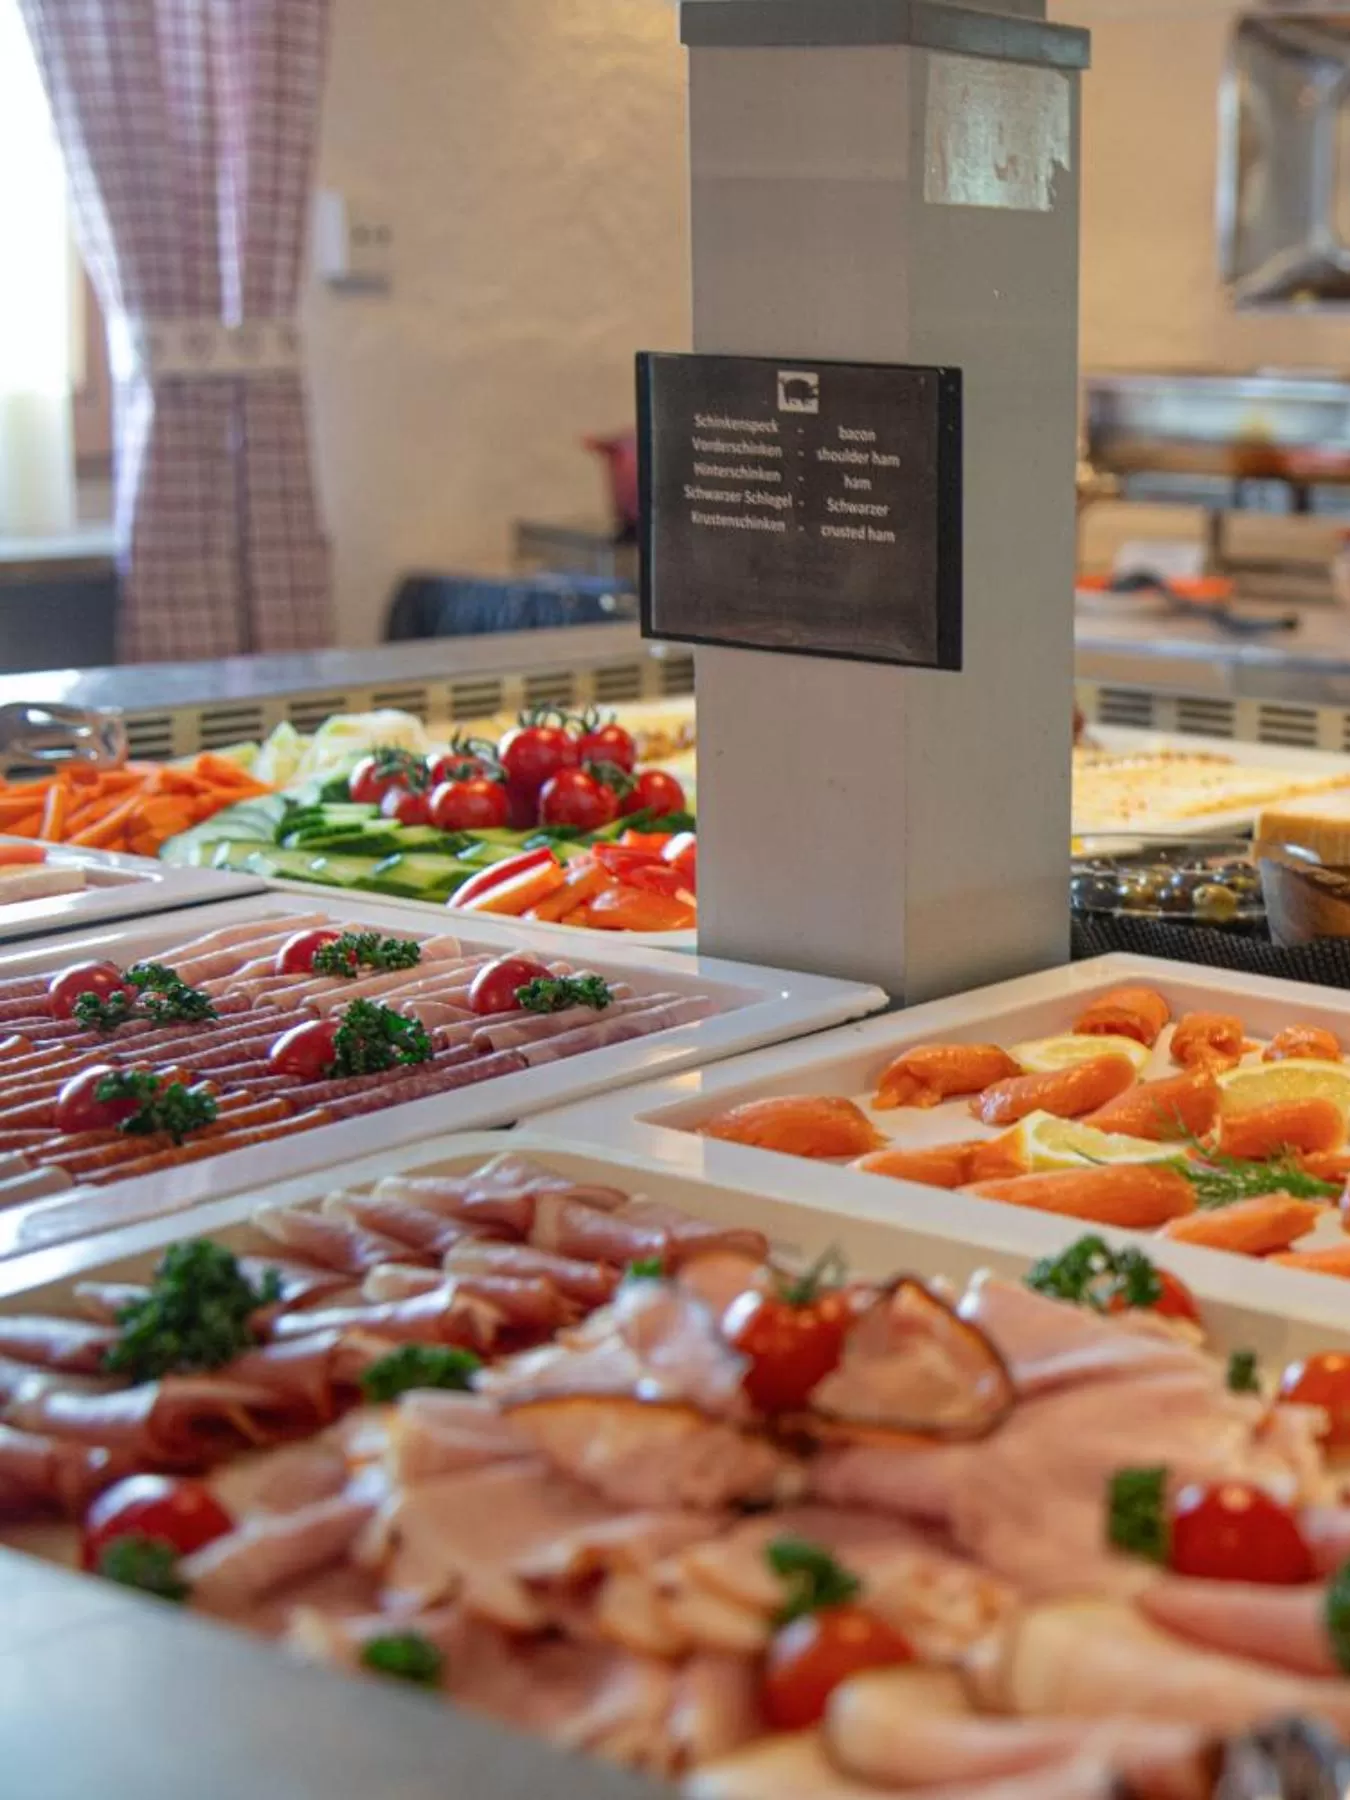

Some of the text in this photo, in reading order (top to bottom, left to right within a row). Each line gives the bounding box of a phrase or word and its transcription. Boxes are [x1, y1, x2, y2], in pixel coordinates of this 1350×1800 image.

[694, 413, 877, 442] Schinkenspeck bacon
[692, 437, 900, 467] Vorderschinken shoulder ham
[693, 462, 872, 490] Hinterschinken ham
[684, 484, 742, 503] Schwarzer
[827, 497, 890, 516] Schwarzer
[691, 511, 895, 543] Krustenschinken crusted ham
